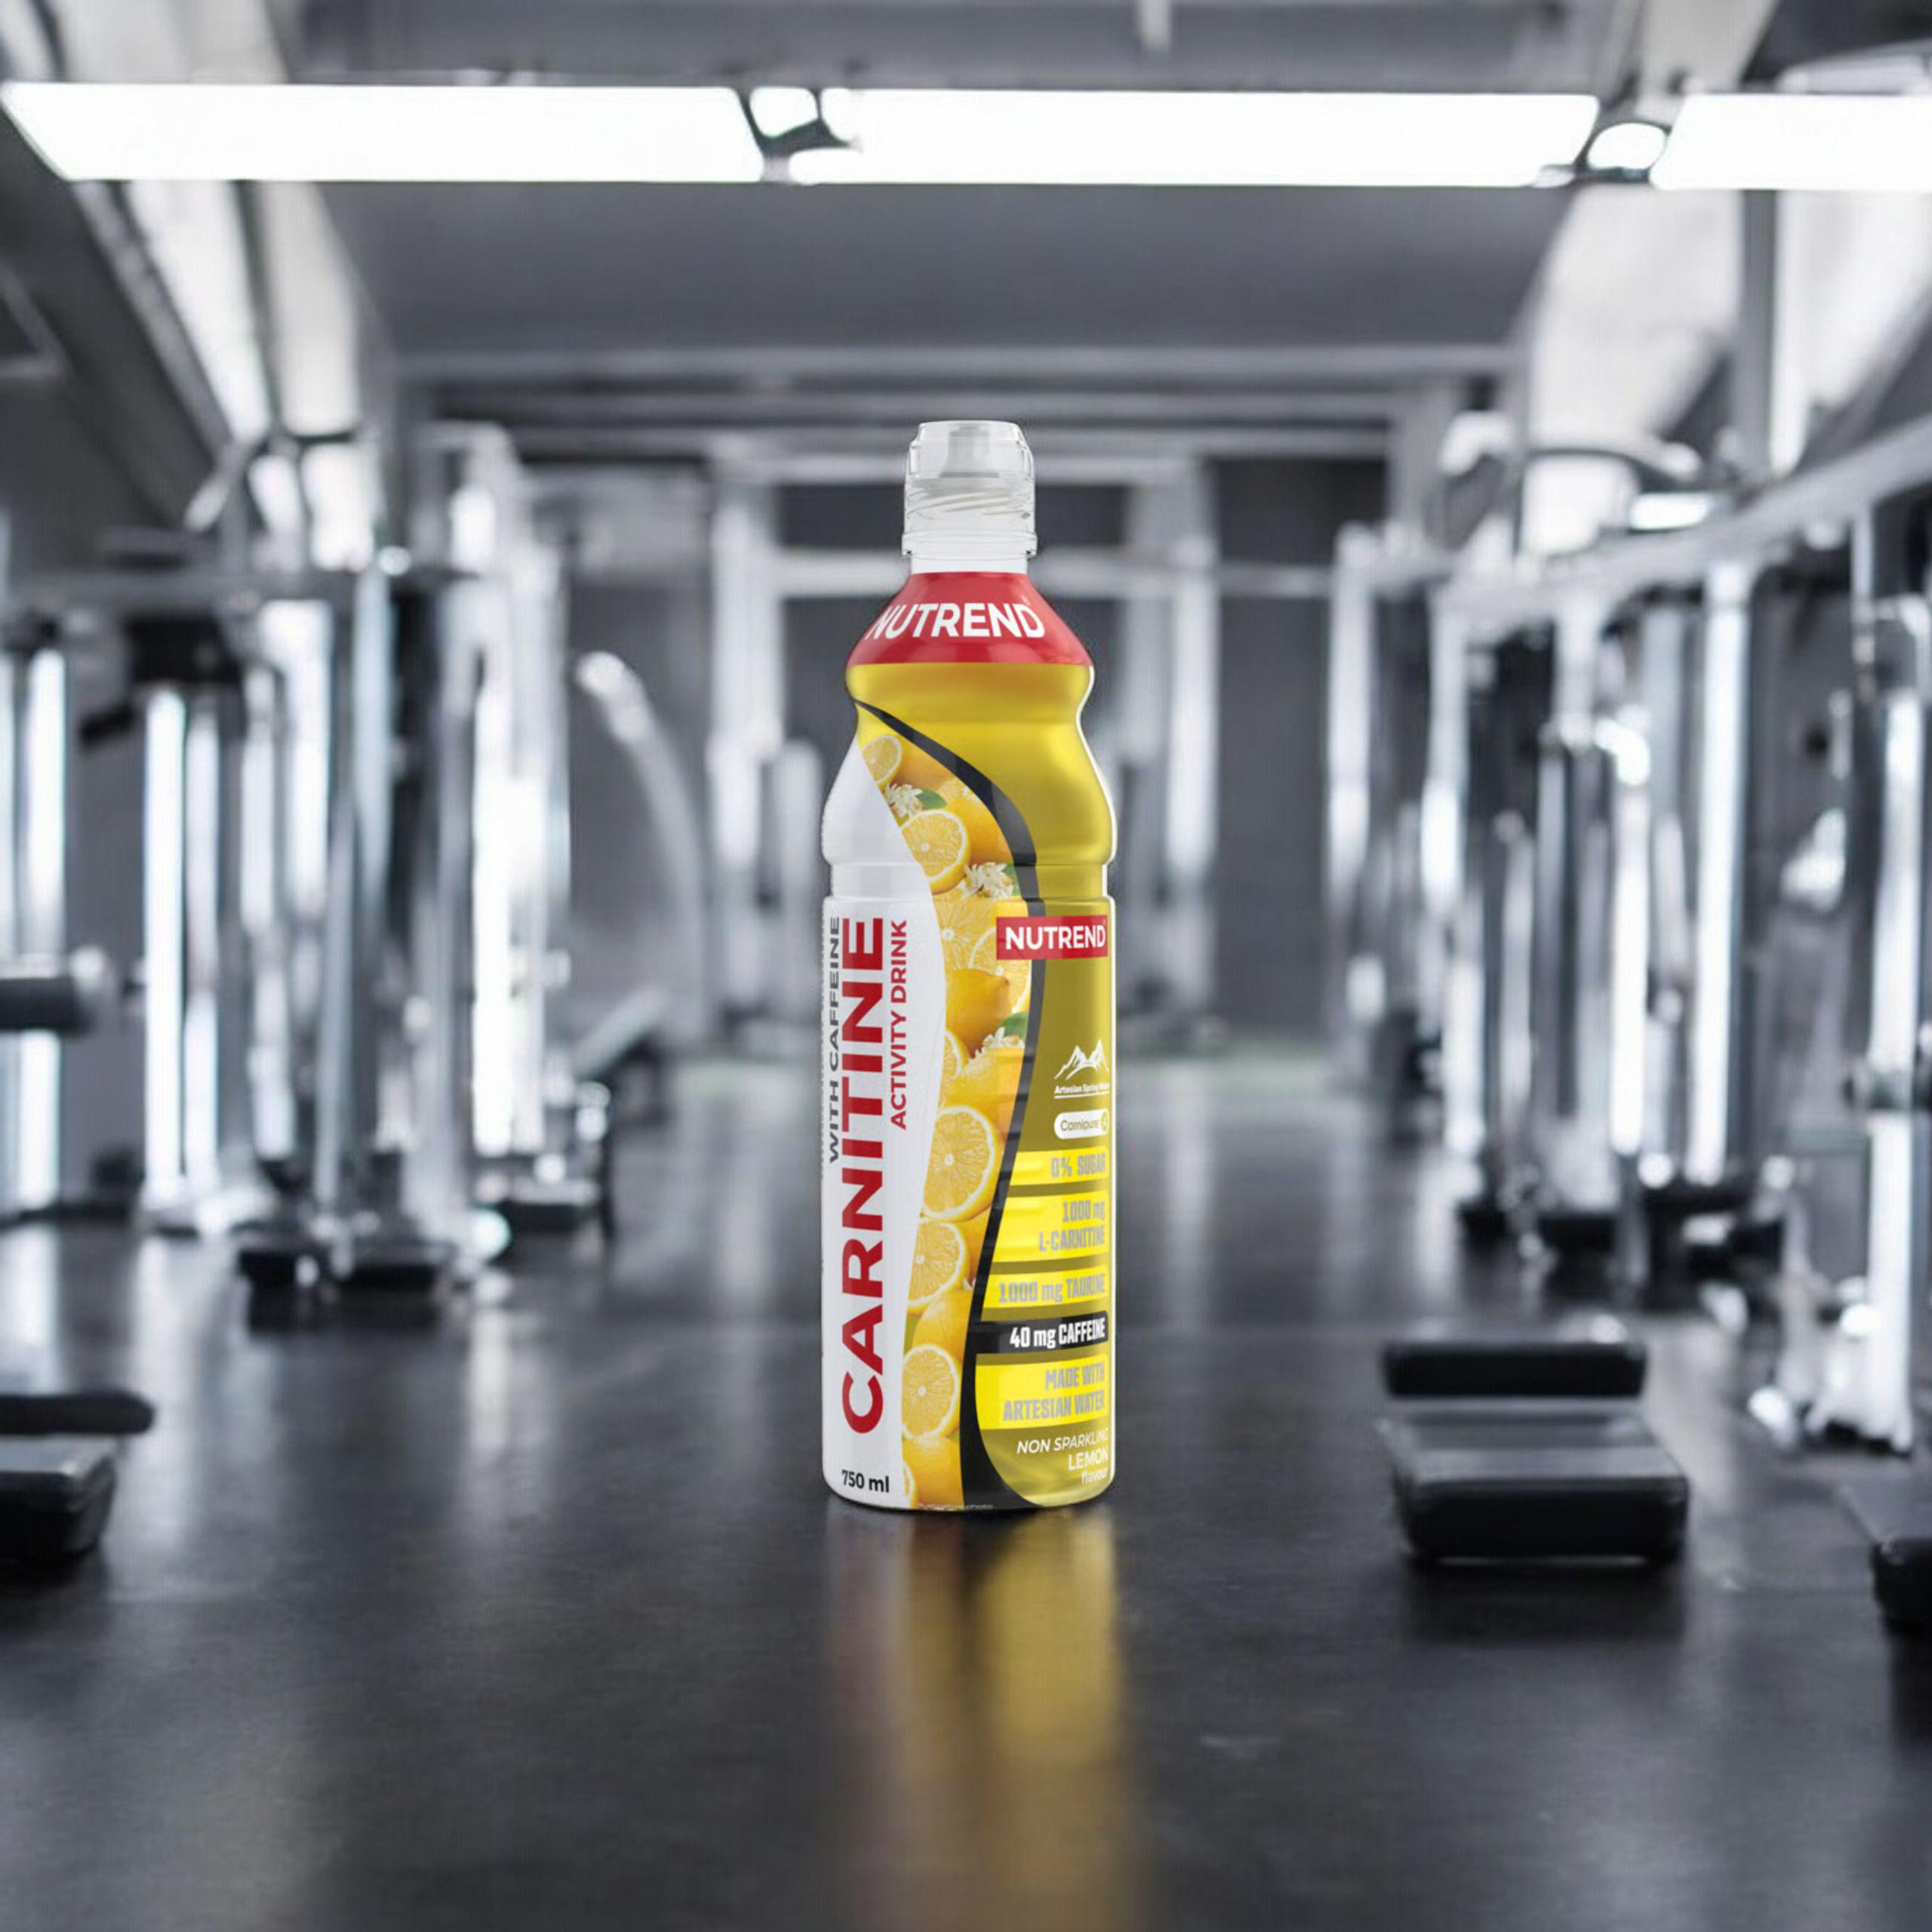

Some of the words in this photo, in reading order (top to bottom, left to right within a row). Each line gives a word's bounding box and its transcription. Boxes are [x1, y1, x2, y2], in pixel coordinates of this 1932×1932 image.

[865, 602, 1045, 640] NUTREND
[1005, 924, 1106, 950] NUTREND
[891, 920, 906, 1003] DRINK
[829, 917, 839, 1072] CAFFEINE
[891, 1011, 906, 1130] ACTIVITY
[829, 1079, 839, 1163] WITH
[841, 918, 883, 1434] CARNITINE
[1051, 1156, 1072, 1177] 0%
[1077, 1152, 1106, 1176] SUGAR
[1063, 1199, 1091, 1223] 1000
[1093, 1201, 1106, 1220] mg
[1038, 1225, 1106, 1252] L-CARNITINE
[998, 1281, 1038, 1303] 1000
[1041, 1283, 1063, 1303] mg
[1066, 1273, 1106, 1299] TAURINE
[1010, 1326, 1030, 1348] 40
[1034, 1329, 1056, 1349] mg
[1059, 1317, 1106, 1345] CAFFEINE
[1045, 1367, 1079, 1390] MADE
[1082, 1361, 1106, 1386] WITH
[1003, 1395, 1072, 1422] ARTESIAN
[1074, 1389, 1105, 1415] WATER
[1017, 1439, 1051, 1454] NON
[1068, 1447, 1109, 1472] LEMON
[841, 1469, 865, 1489] 750
[868, 1475, 890, 1493] ml
